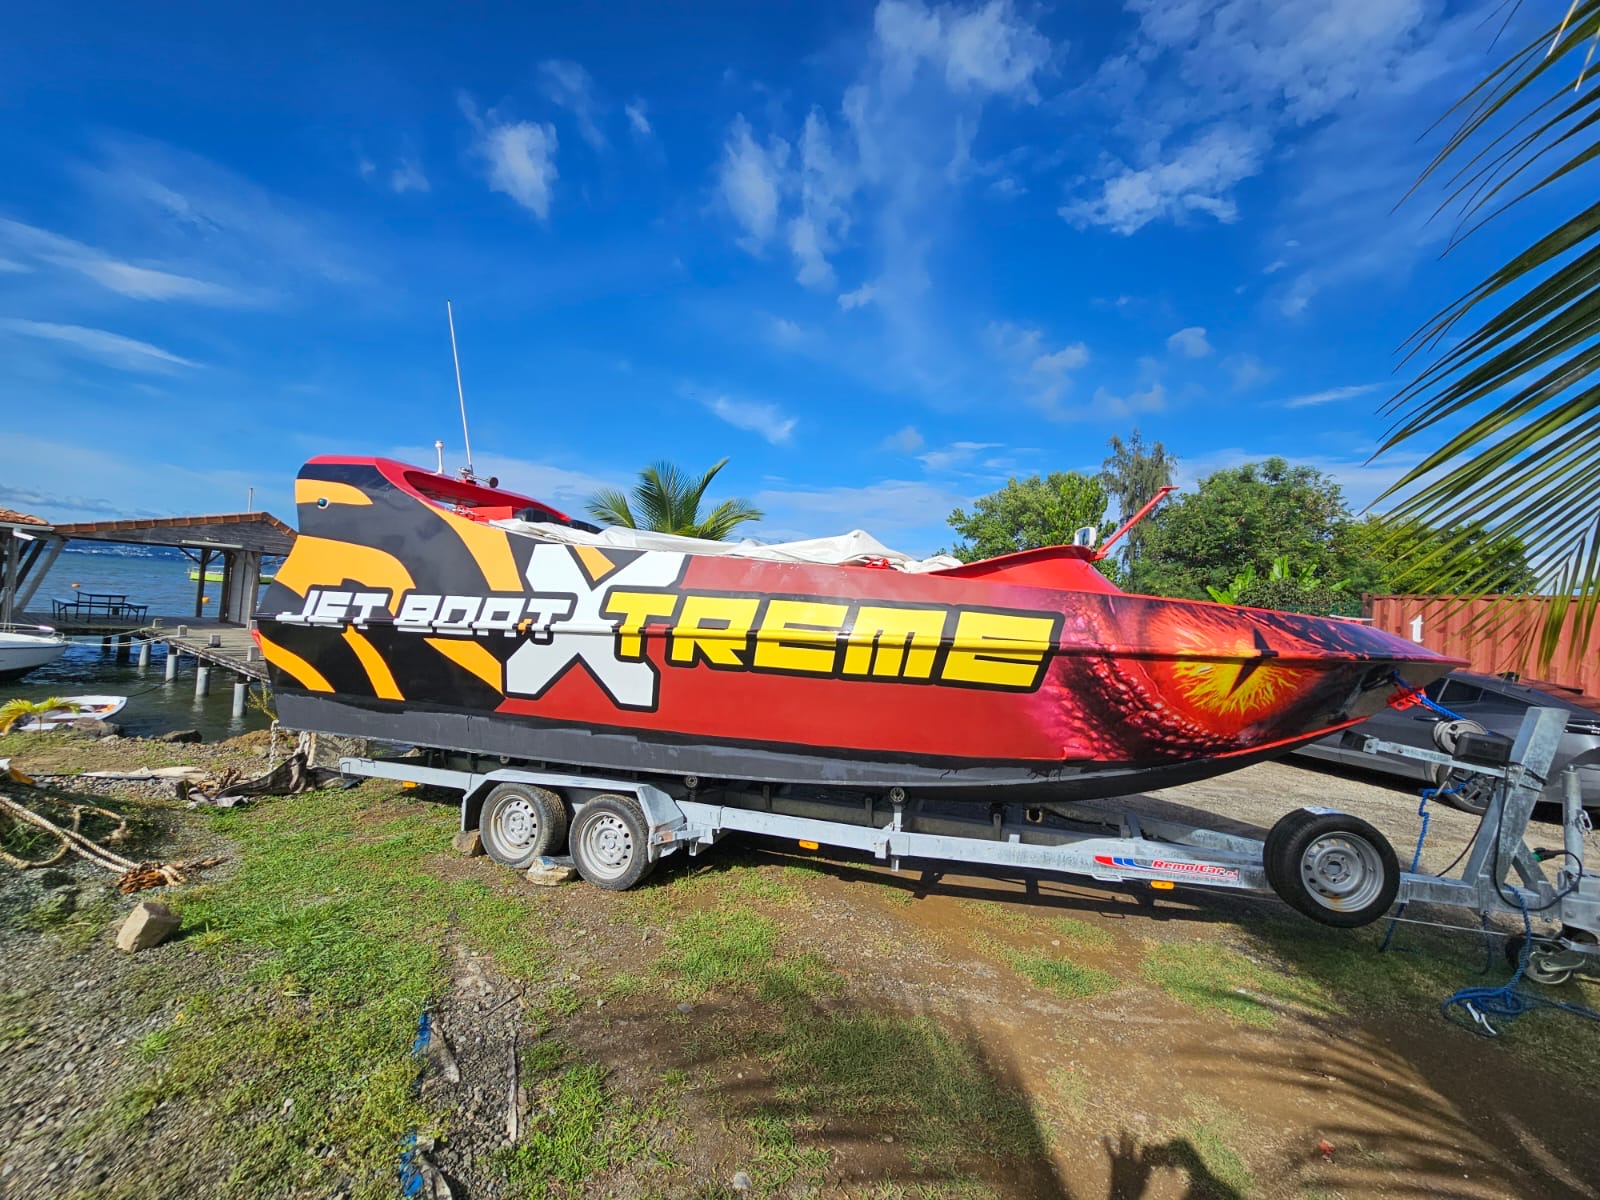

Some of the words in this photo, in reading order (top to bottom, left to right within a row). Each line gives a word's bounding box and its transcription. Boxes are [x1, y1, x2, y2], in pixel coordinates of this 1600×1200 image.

[276, 590, 389, 629] JET
[393, 593, 572, 639] BOAT
[506, 543, 1055, 706] XTREME
